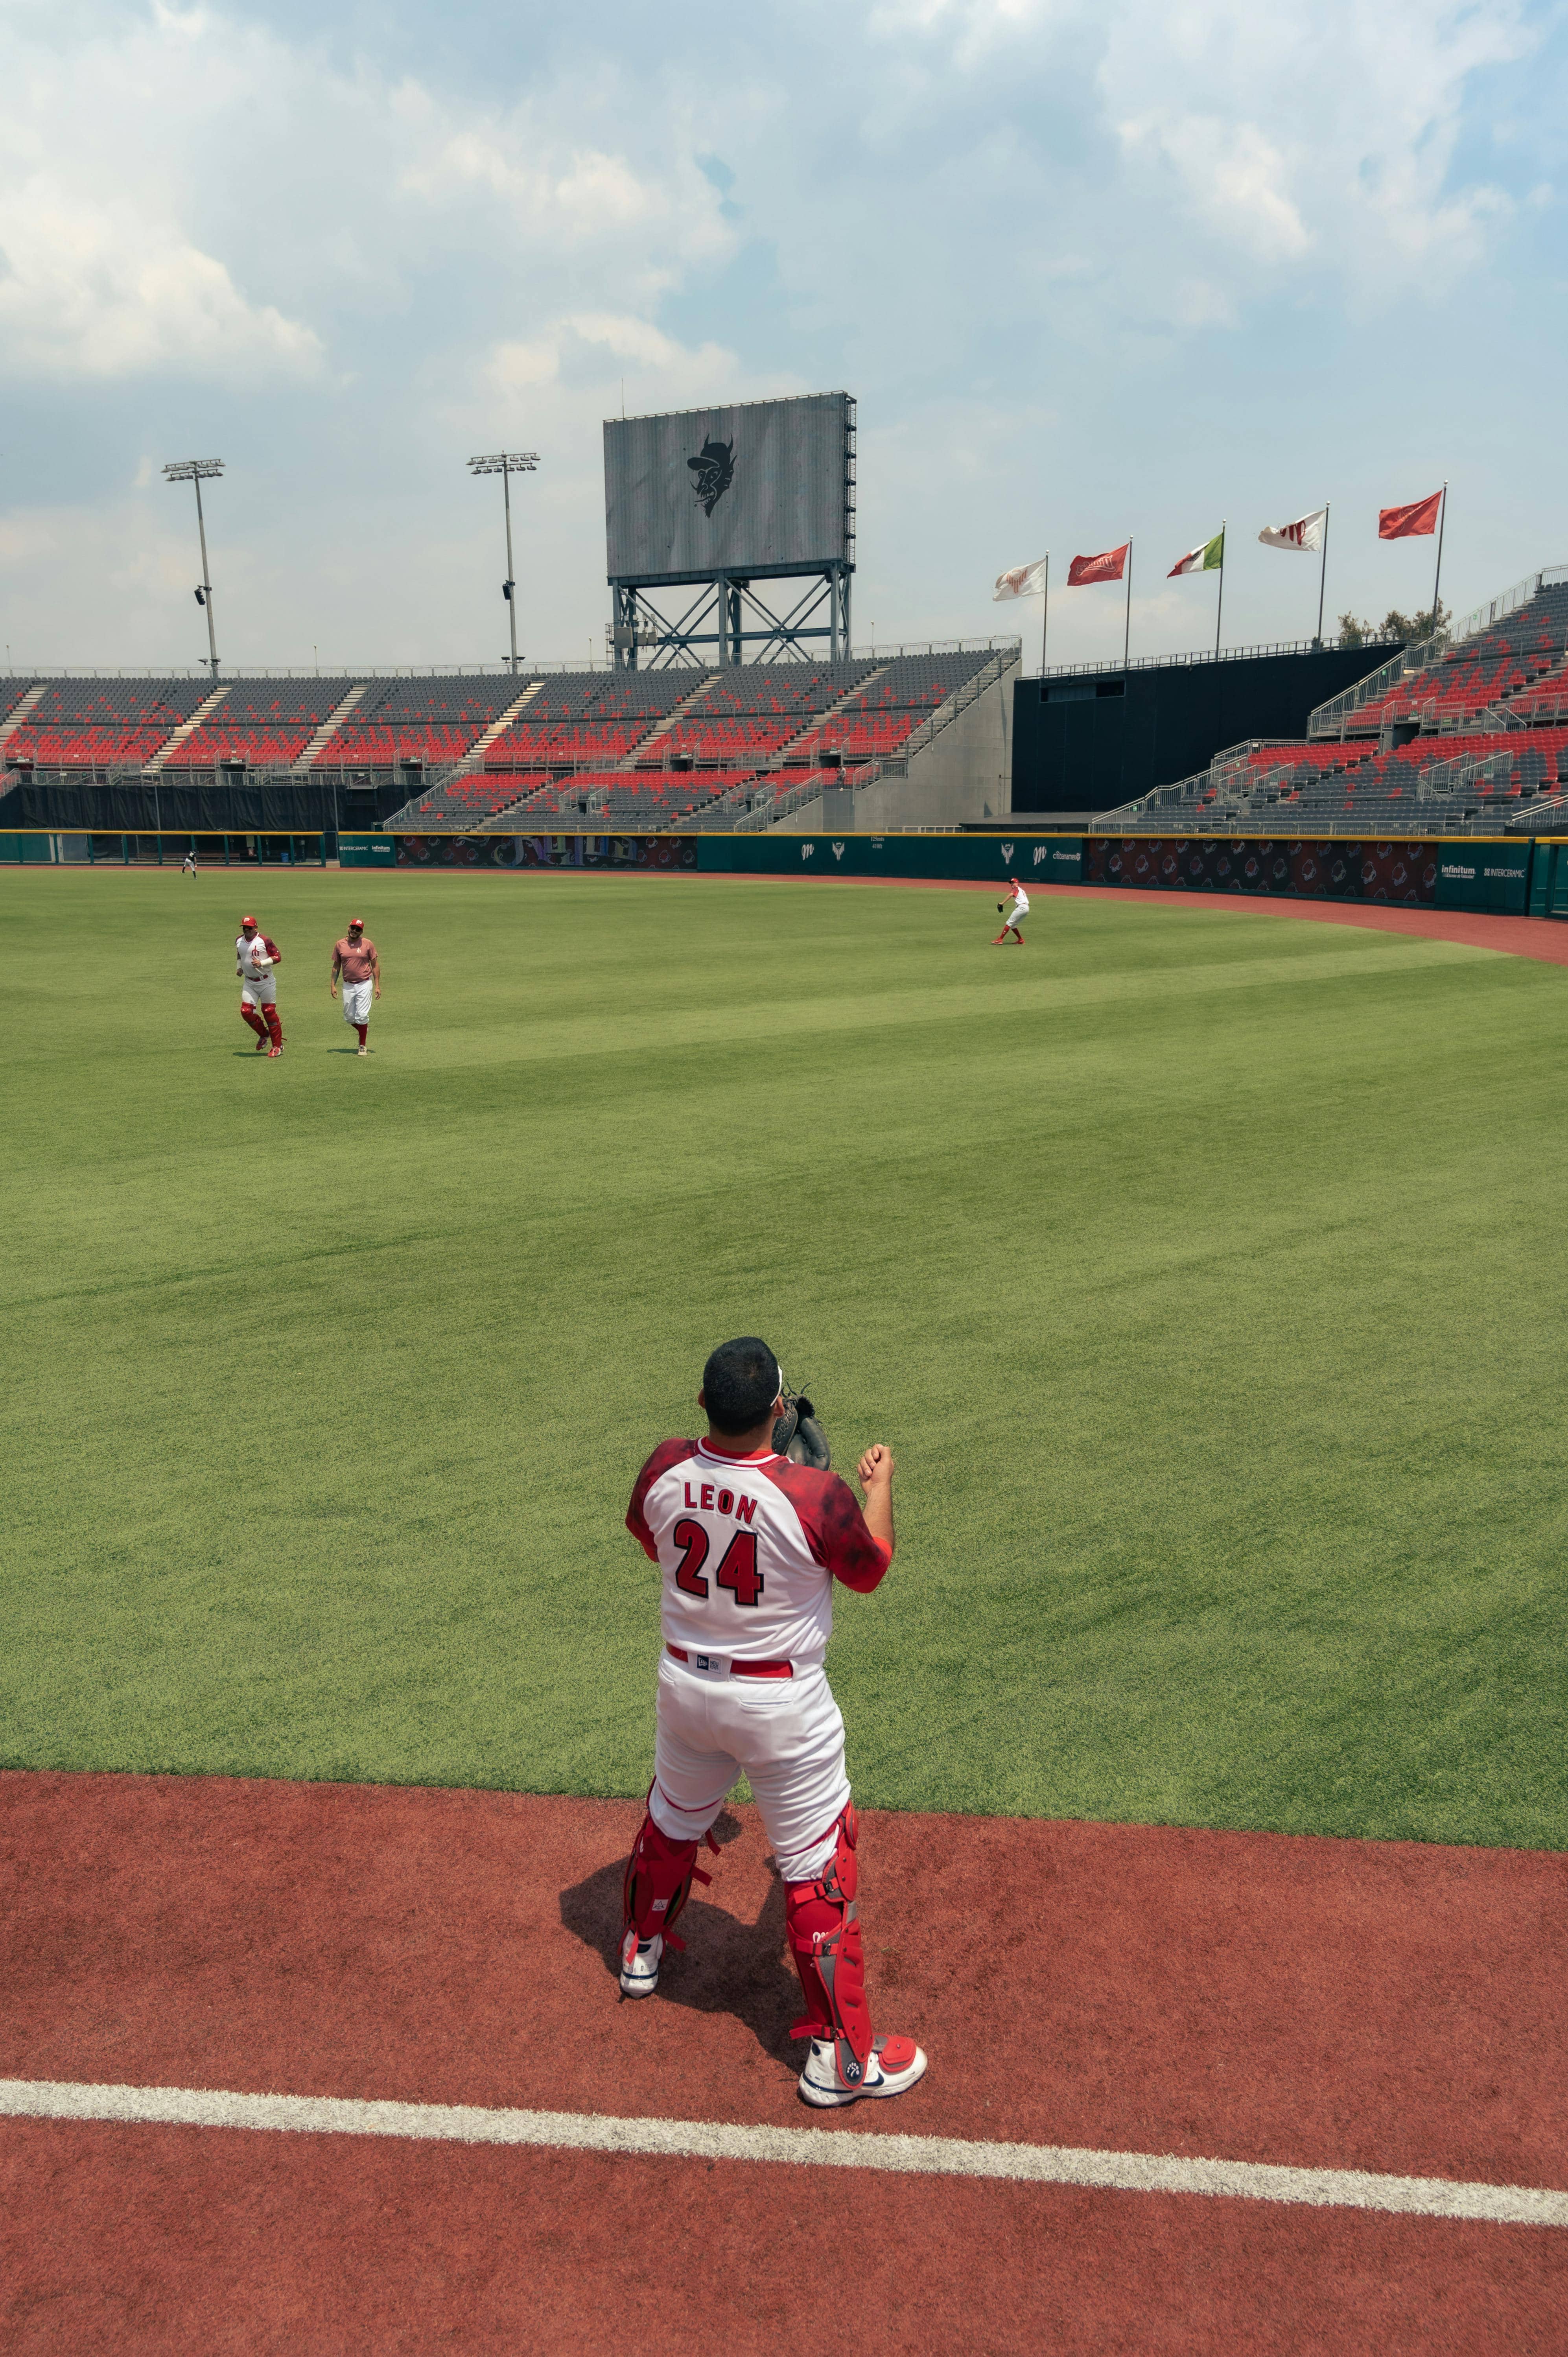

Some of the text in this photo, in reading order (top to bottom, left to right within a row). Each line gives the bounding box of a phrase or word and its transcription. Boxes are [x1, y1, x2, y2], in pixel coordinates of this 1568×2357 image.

[1441, 864, 1475, 874] infinitum
[1491, 868, 1525, 878] INTERCERAMIC
[684, 1482, 757, 1524] LEON
[674, 1518, 765, 1606] 24
